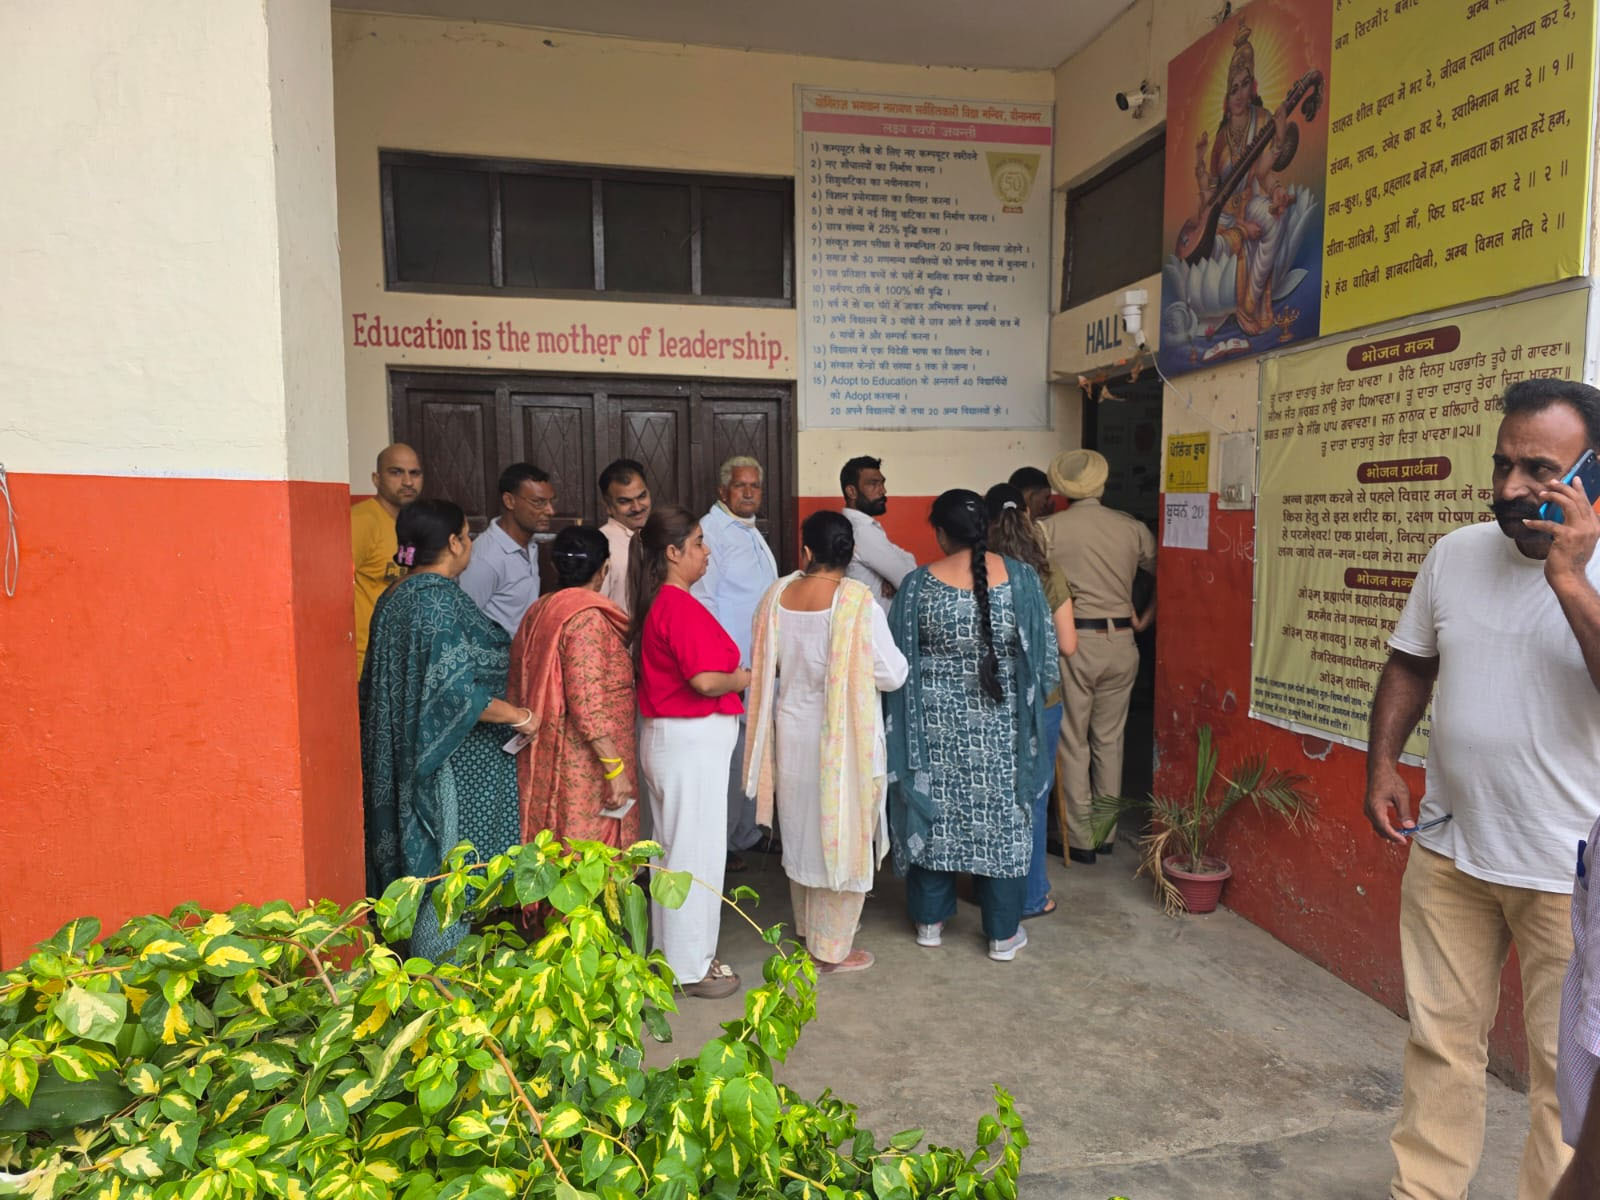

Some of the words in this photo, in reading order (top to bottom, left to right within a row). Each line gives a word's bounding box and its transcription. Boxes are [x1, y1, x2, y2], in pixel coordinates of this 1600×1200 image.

[879, 224, 899, 234] 25%
[940, 242, 951, 251] 20
[886, 286, 910, 295] 100%
[352, 312, 467, 350] Education
[472, 320, 491, 350] is
[496, 320, 530, 352] the
[536, 324, 622, 355] mother
[628, 327, 652, 356] of
[658, 328, 788, 370] leadership.
[1086, 314, 1121, 355] HALL
[1362, 345, 1400, 361] भोजन
[1404, 338, 1434, 352] मन्त्र
[831, 376, 858, 386] Adopt
[861, 377, 870, 385] to
[872, 376, 917, 386] Education
[845, 392, 871, 402] Adopt
[1367, 464, 1398, 477] भोजन
[1402, 460, 1438, 477] प्रार्थना
[1282, 495, 1302, 505] अन्न
[1304, 494, 1327, 506] ग्रहण
[1329, 489, 1353, 503] करने
[1356, 488, 1366, 503] से
[1370, 488, 1394, 504] पहले
[1398, 487, 1430, 502] विचार
[1434, 490, 1457, 501] मन
[1461, 484, 1473, 500] में
[1283, 509, 1302, 522] किस
[1306, 509, 1319, 526] हेतु
[1322, 508, 1330, 522] से
[1334, 512, 1349, 524] इस
[1352, 508, 1378, 522] शरीर
[1382, 512, 1401, 524] का,
[1406, 512, 1433, 523] रक्षण
[1438, 507, 1473, 523] पोषण
[1357, 571, 1388, 586] भोजन
